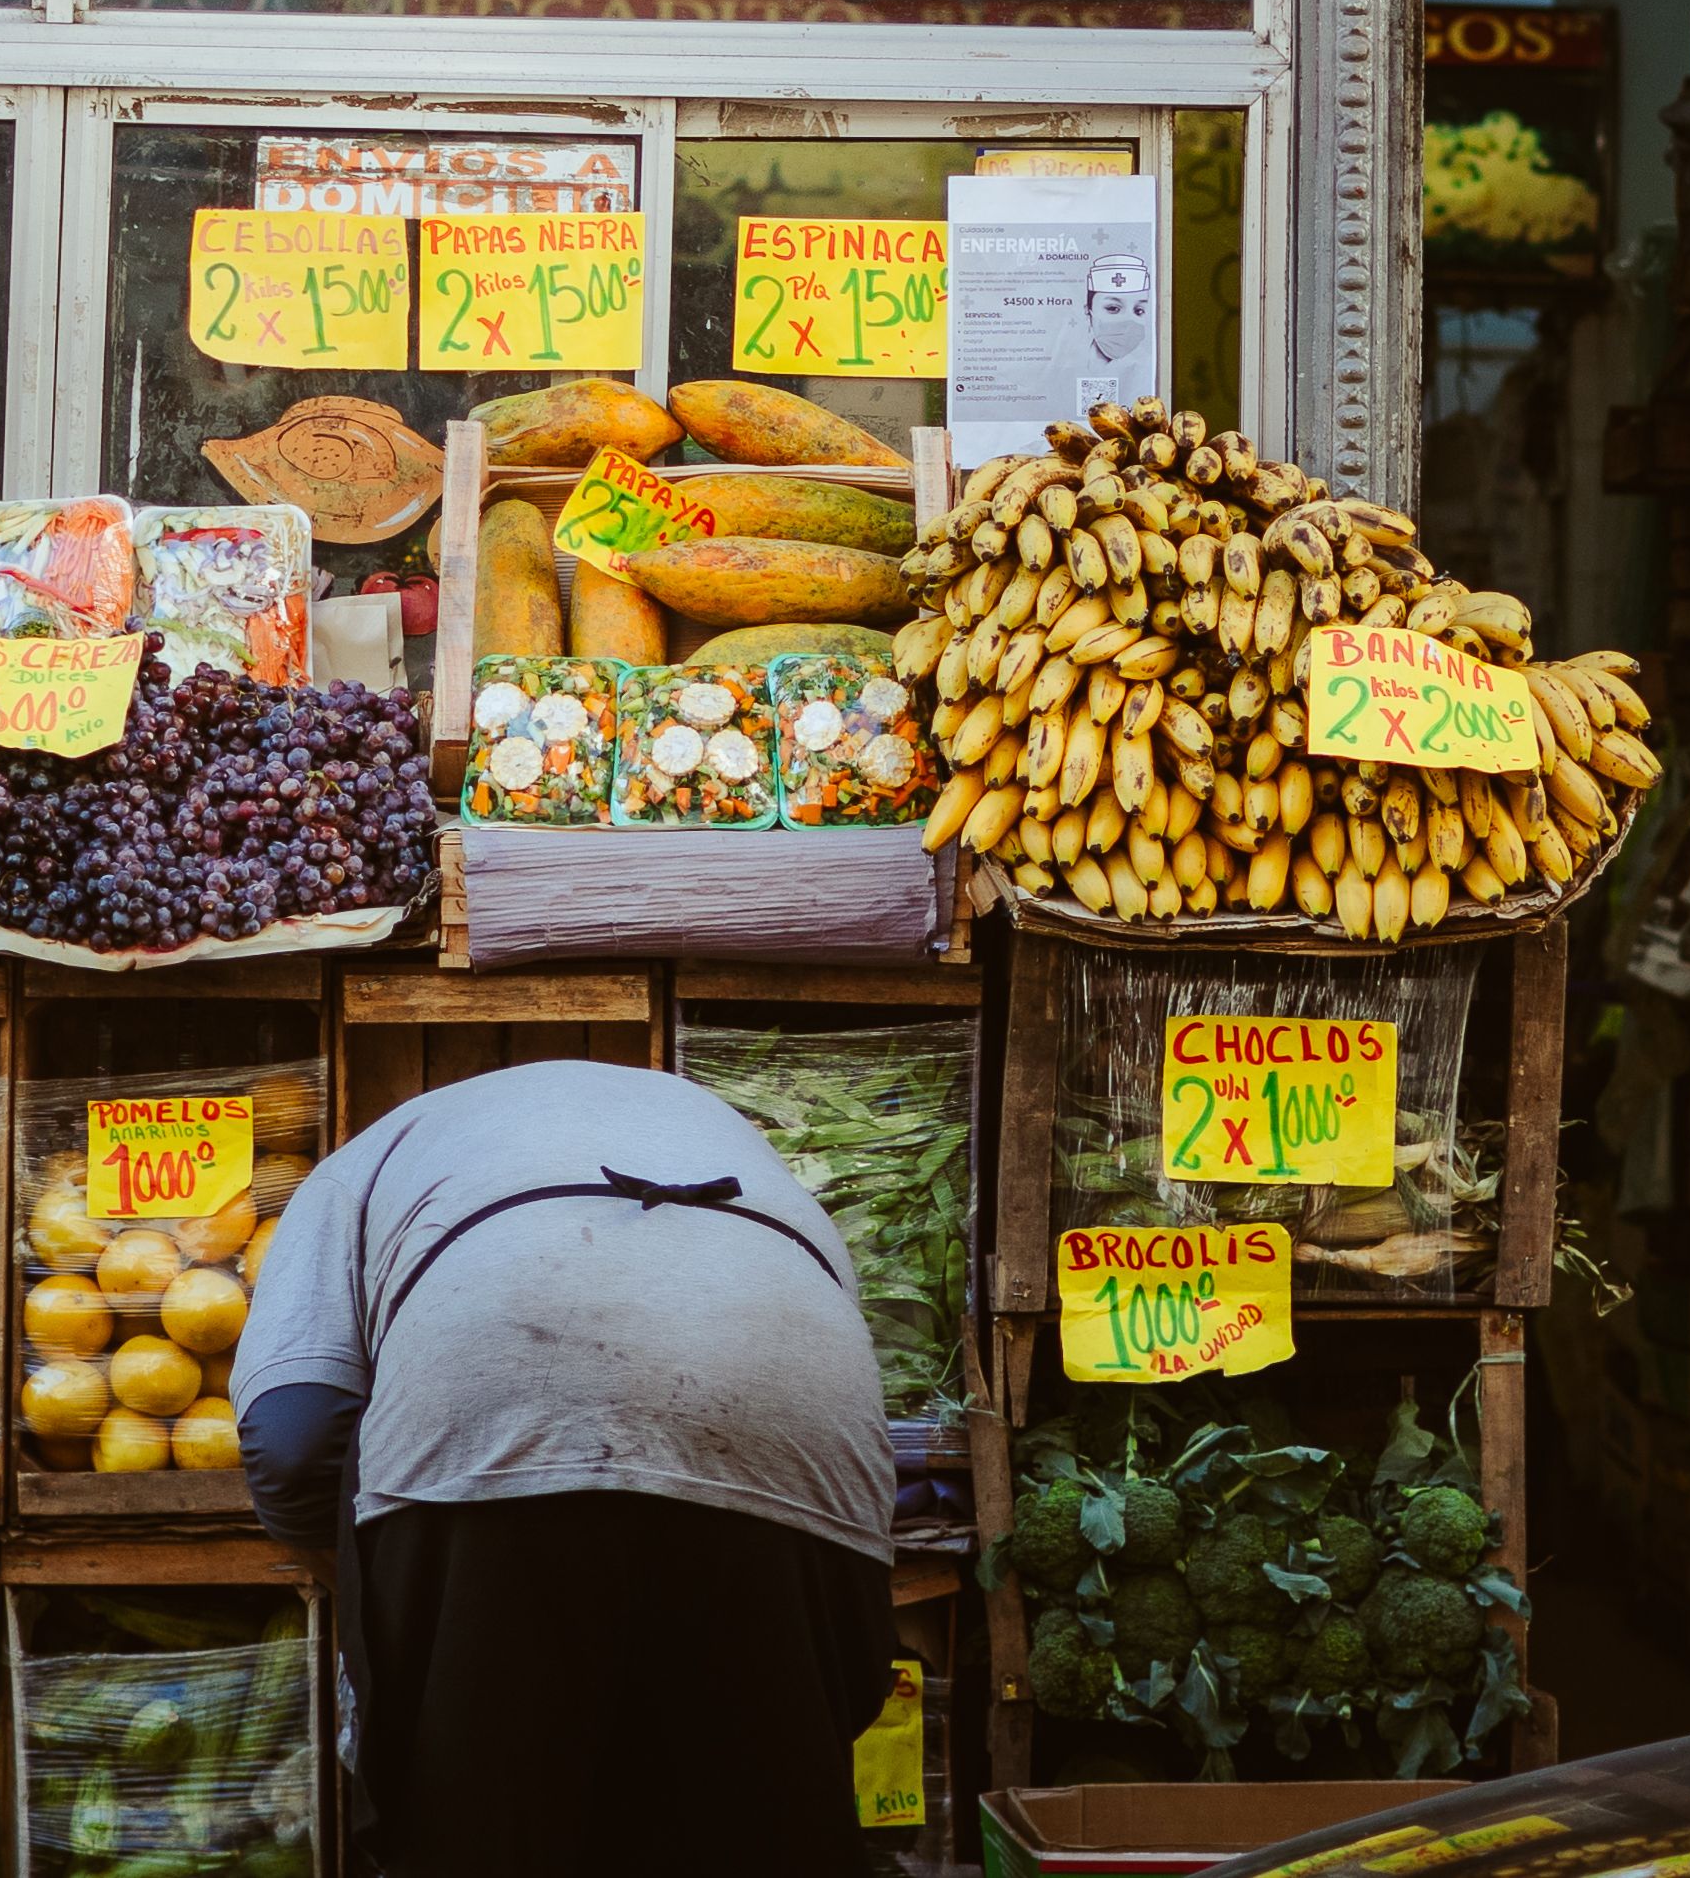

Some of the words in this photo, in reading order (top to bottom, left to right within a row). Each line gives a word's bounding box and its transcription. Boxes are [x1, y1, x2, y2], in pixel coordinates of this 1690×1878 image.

[422, 218, 527, 256] PAPAS
[960, 233, 1080, 253] ENFERMERÍA
[1045, 253, 1090, 261] DOMICILIO
[204, 262, 242, 343] 2
[436, 268, 474, 353] 2
[743, 275, 784, 360] 2
[1003, 296, 1035, 307] $4500
[1046, 296, 1074, 307] Hora
[602, 451, 717, 538] PAPAYA
[20, 638, 140, 671] CEREZA
[1321, 629, 1495, 693] BANANA
[1325, 675, 1371, 746] 2
[1172, 1022, 1384, 1066] CHOCLOS
[89, 1098, 251, 1130] POMELOS
[1171, 1074, 1216, 1172] 2
